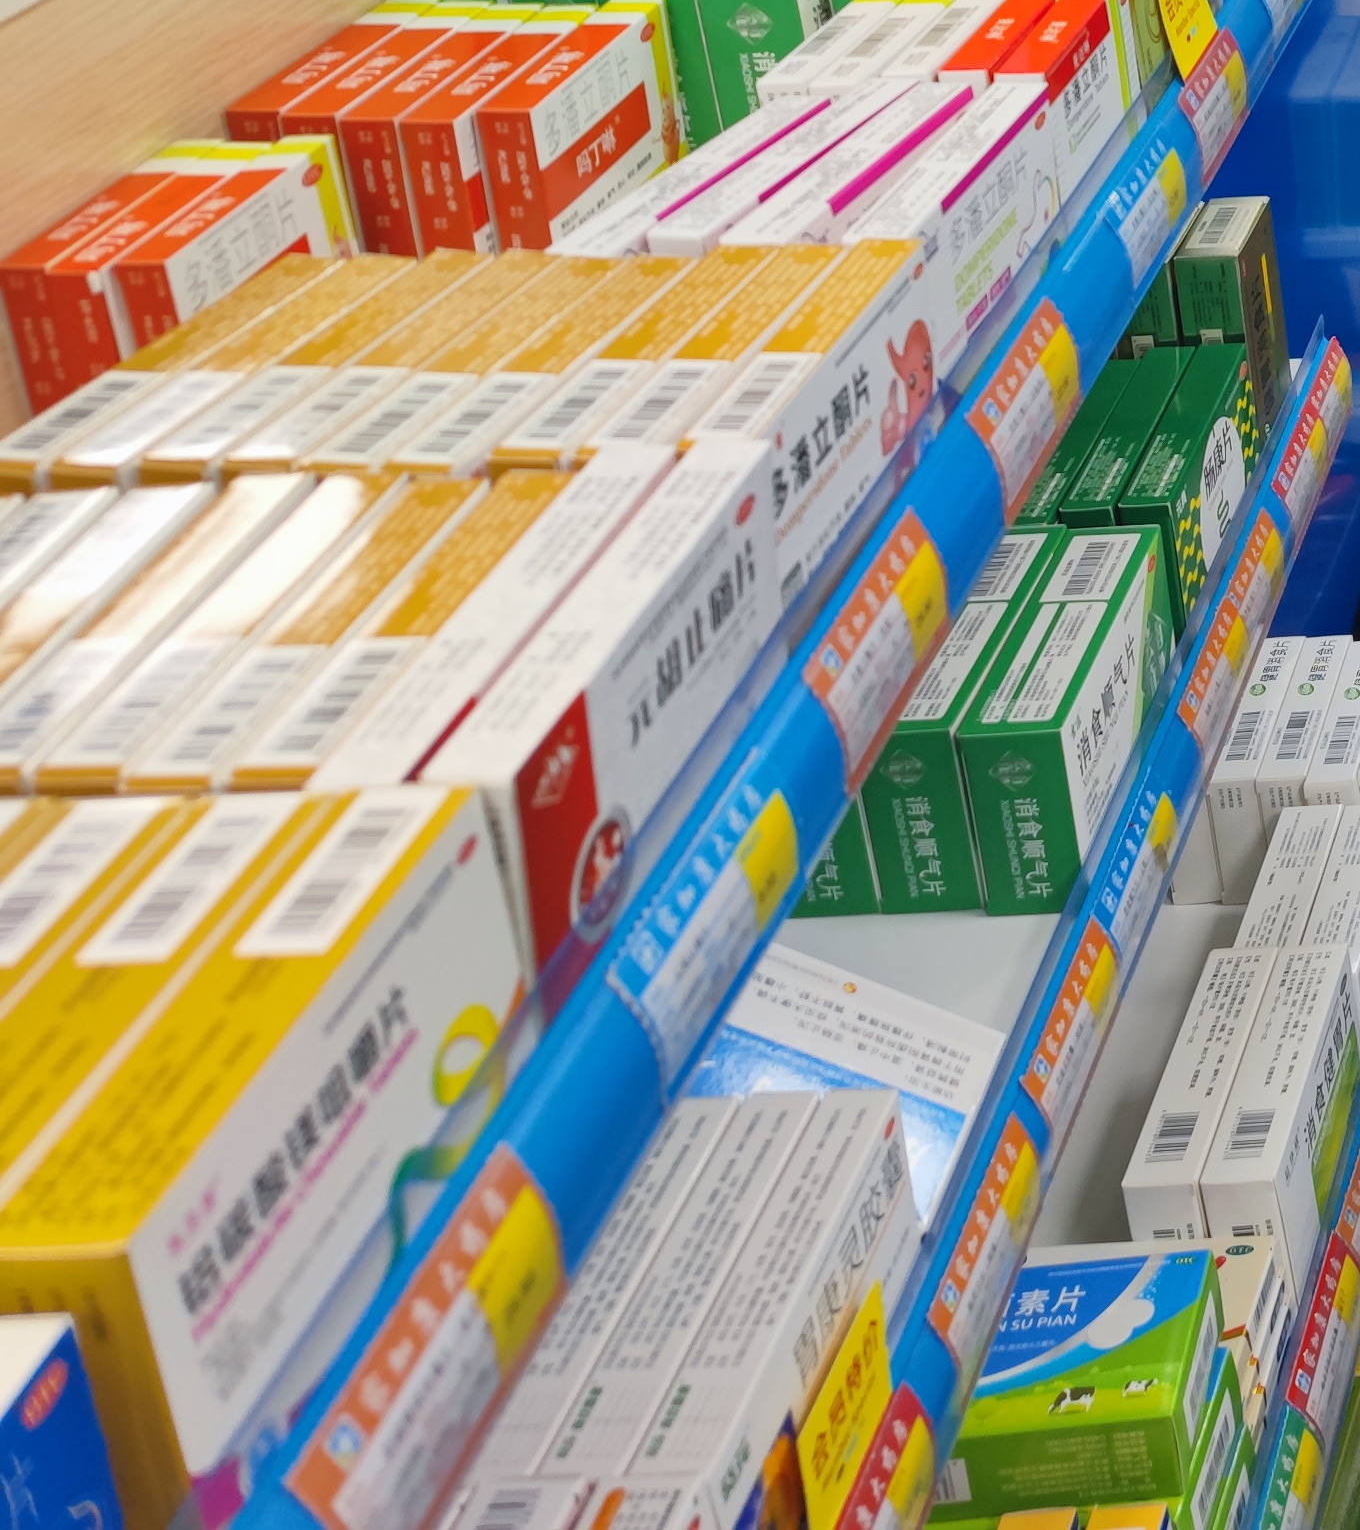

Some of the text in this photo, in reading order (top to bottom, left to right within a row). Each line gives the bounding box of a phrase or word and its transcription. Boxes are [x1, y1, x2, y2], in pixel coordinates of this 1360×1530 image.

[574, 128, 618, 177] 吗丁啉
[904, 796, 947, 897] 消食顺气片
[1014, 796, 1053, 899] 消食顺气片
[1009, 1312, 1077, 1331] SU PIAN
[811, 1319, 880, 1480] 会员特价
